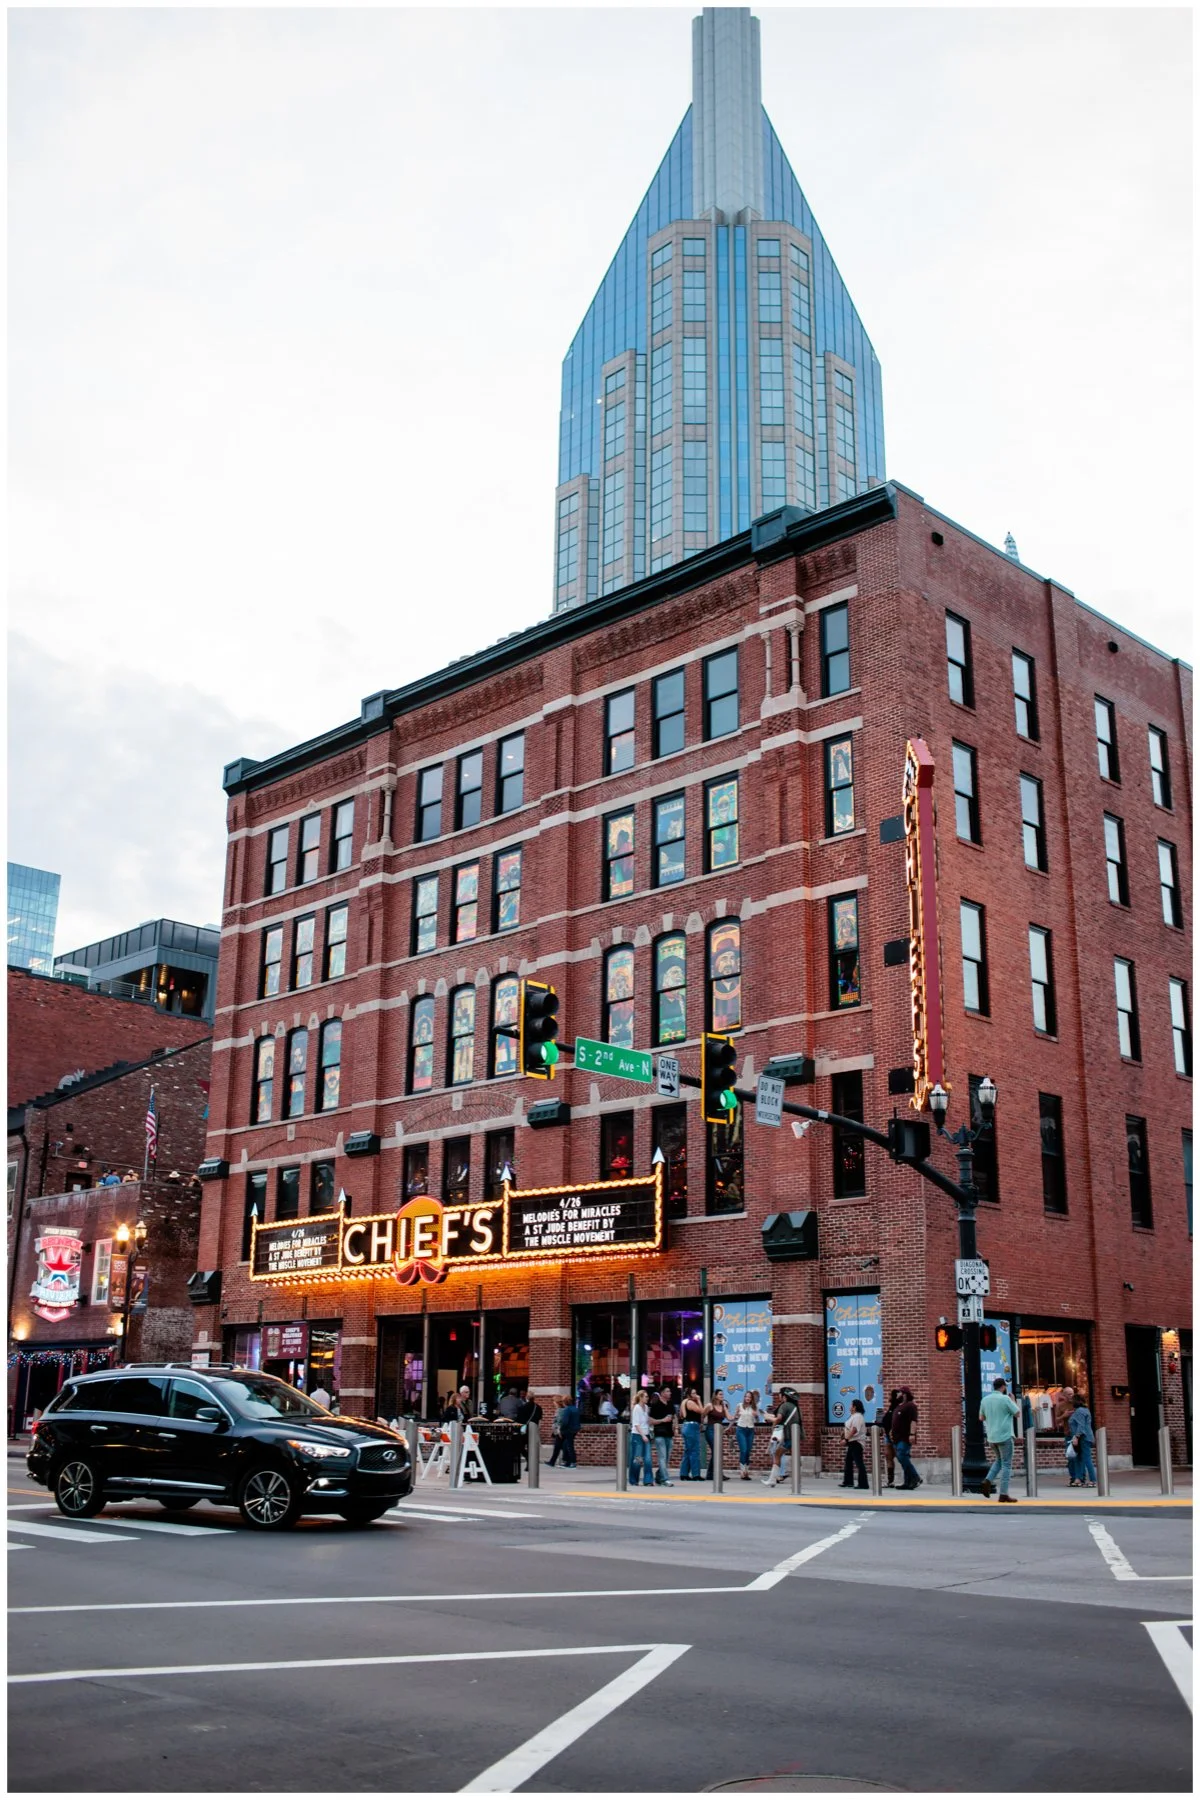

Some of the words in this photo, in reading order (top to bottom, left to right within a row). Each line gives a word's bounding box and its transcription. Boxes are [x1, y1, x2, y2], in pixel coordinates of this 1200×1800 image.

[659, 1060, 678, 1072] ONE
[659, 1071, 678, 1083] WAY
[760, 1081, 769, 1091] DO
[771, 1084, 782, 1094] NOT
[760, 1095, 779, 1107] BLOCK
[559, 1196, 582, 1208] 4/26
[523, 1208, 560, 1224] MELODIES
[563, 1208, 578, 1220] FOR
[581, 1205, 621, 1219] MIRACLES
[524, 1225, 531, 1235] A
[533, 1224, 543, 1235] ST
[545, 1222, 566, 1234] JUDE
[567, 1219, 600, 1232] BENEFIT
[602, 1218, 615, 1229] BY
[343, 1208, 495, 1265] CHIEF'S
[524, 1236, 539, 1248] THE
[541, 1234, 571, 1247] MUSCLE
[573, 1230, 616, 1243] MOVEMENT
[958, 1277, 971, 1290] OK
[732, 1342, 761, 1352] VOTED
[844, 1337, 874, 1346] VOTED
[836, 1347, 858, 1357] BEST
[862, 1346, 882, 1356] NEW
[724, 1354, 746, 1363] BEST
[750, 1353, 770, 1362] NEW
[850, 1357, 869, 1367] BAR
[737, 1364, 757, 1373] BAR
